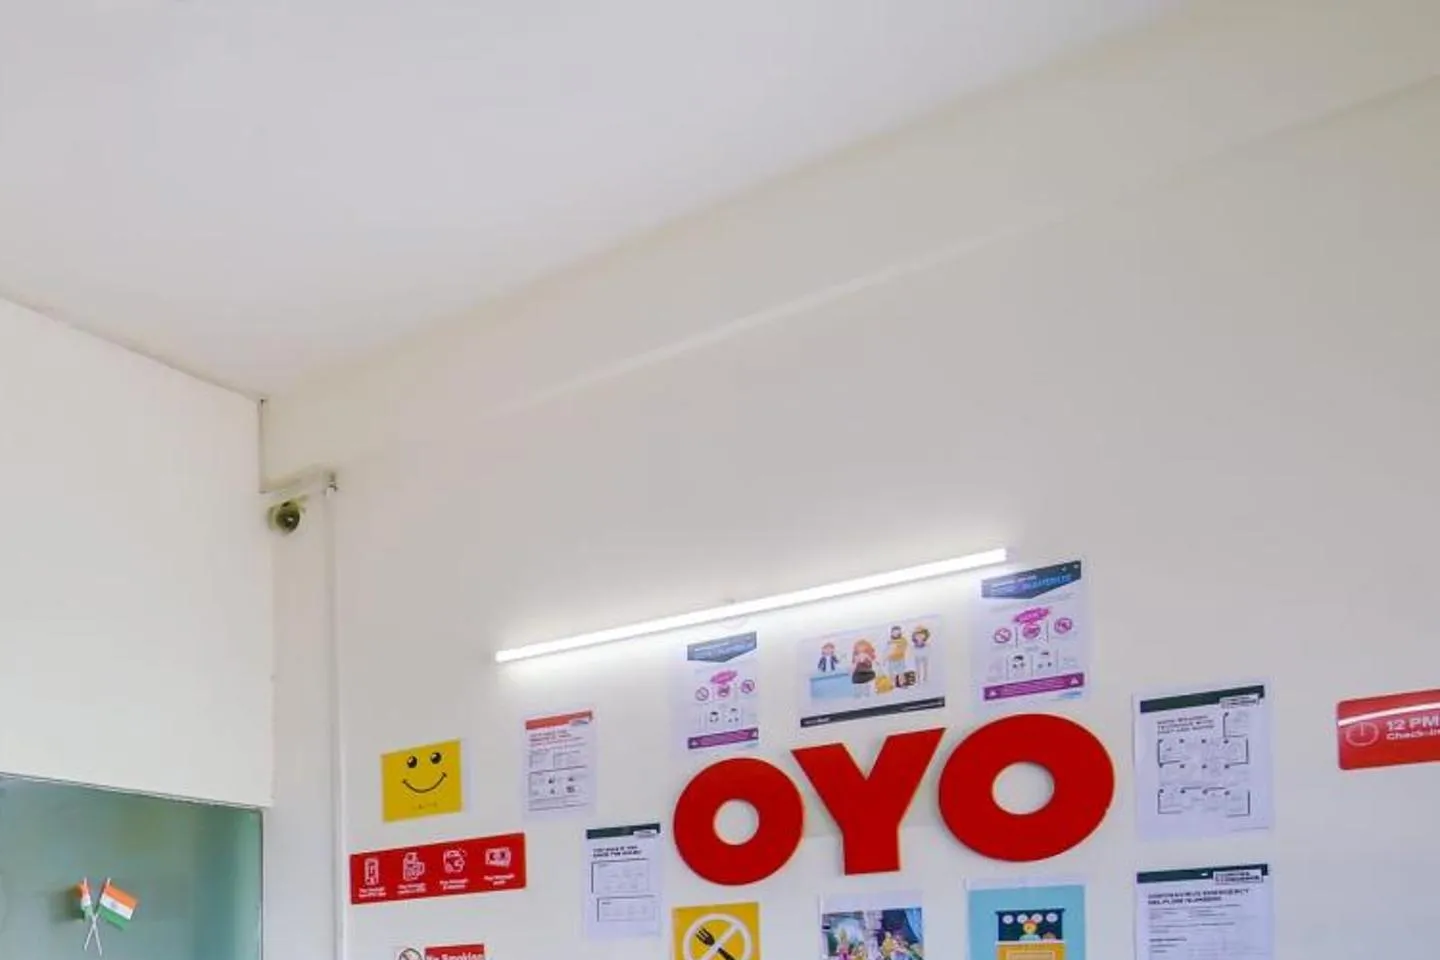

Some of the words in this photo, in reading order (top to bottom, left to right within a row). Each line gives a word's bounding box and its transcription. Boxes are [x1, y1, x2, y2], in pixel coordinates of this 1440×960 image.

[1387, 719, 1406, 731] 12
[1409, 715, 1439, 728] PM
[673, 713, 1115, 886] OYO
